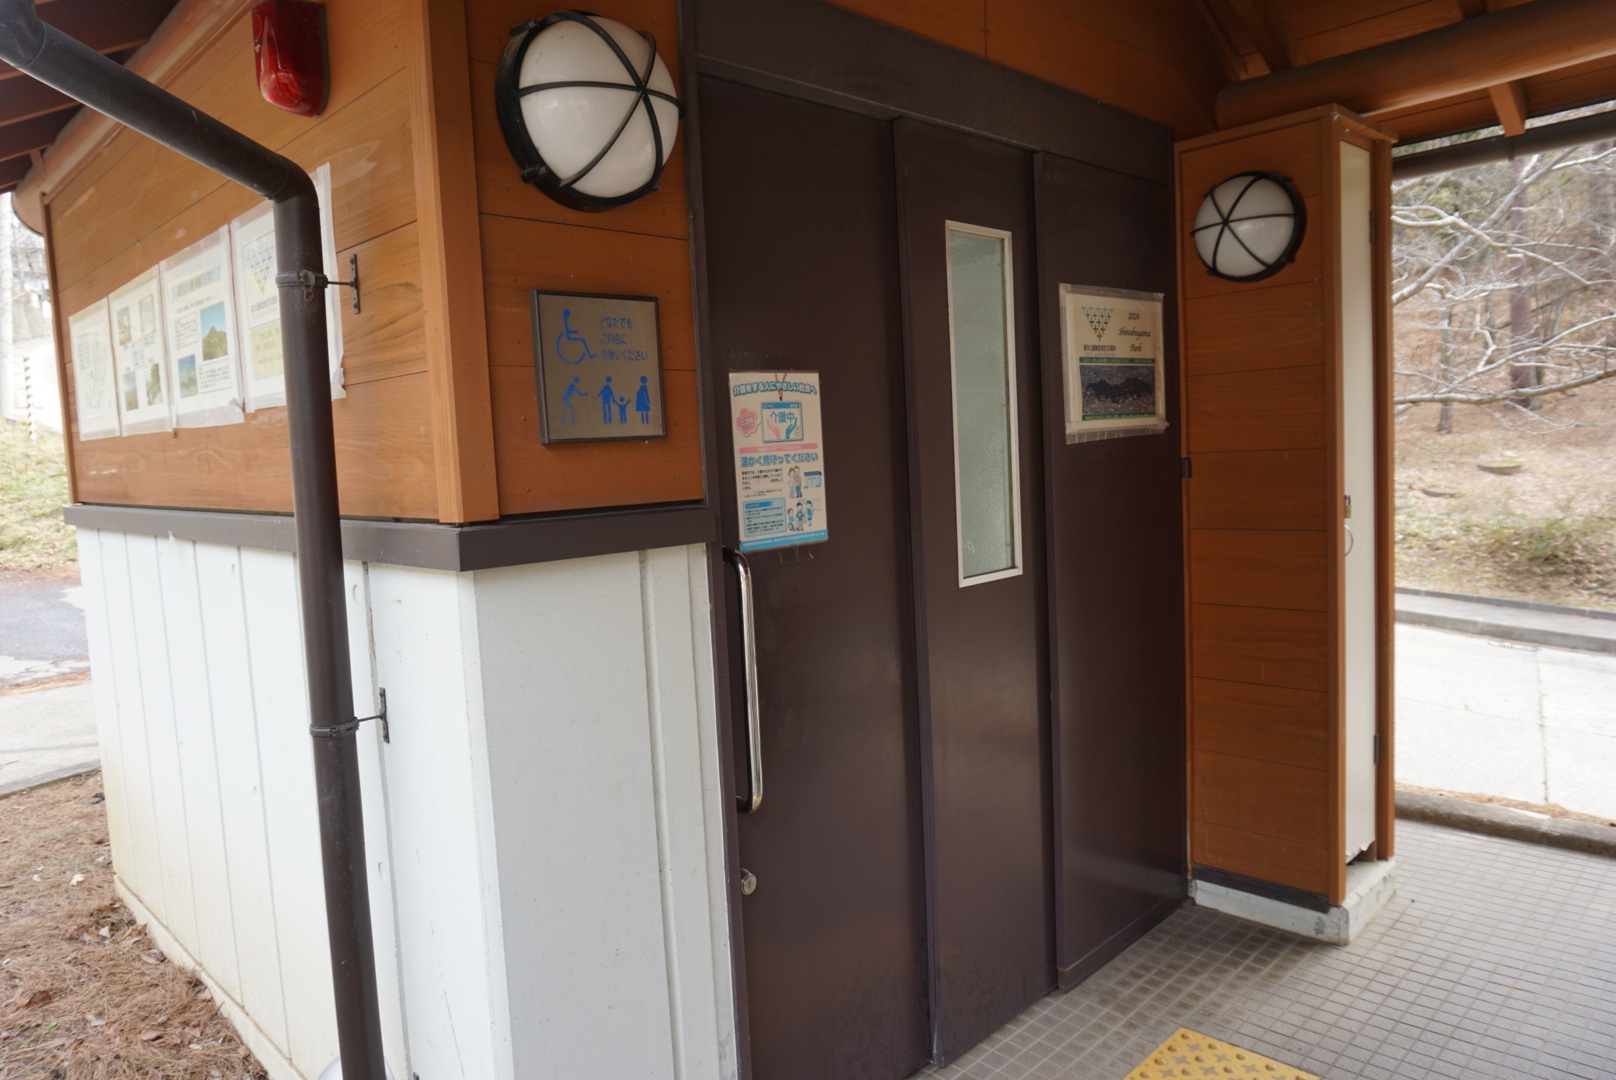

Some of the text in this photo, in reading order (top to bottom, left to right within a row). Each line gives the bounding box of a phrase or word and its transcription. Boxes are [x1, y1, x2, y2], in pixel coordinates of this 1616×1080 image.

[599, 317, 633, 329] どなたでも
[600, 333, 628, 345] ご自由に
[1129, 342, 1143, 352] Park
[601, 349, 648, 361] お使いください
[733, 381, 818, 396] 介護をする人にやさしい社会へ
[769, 410, 796, 423] 介護中
[740, 452, 819, 467] 温かく見守ってください
